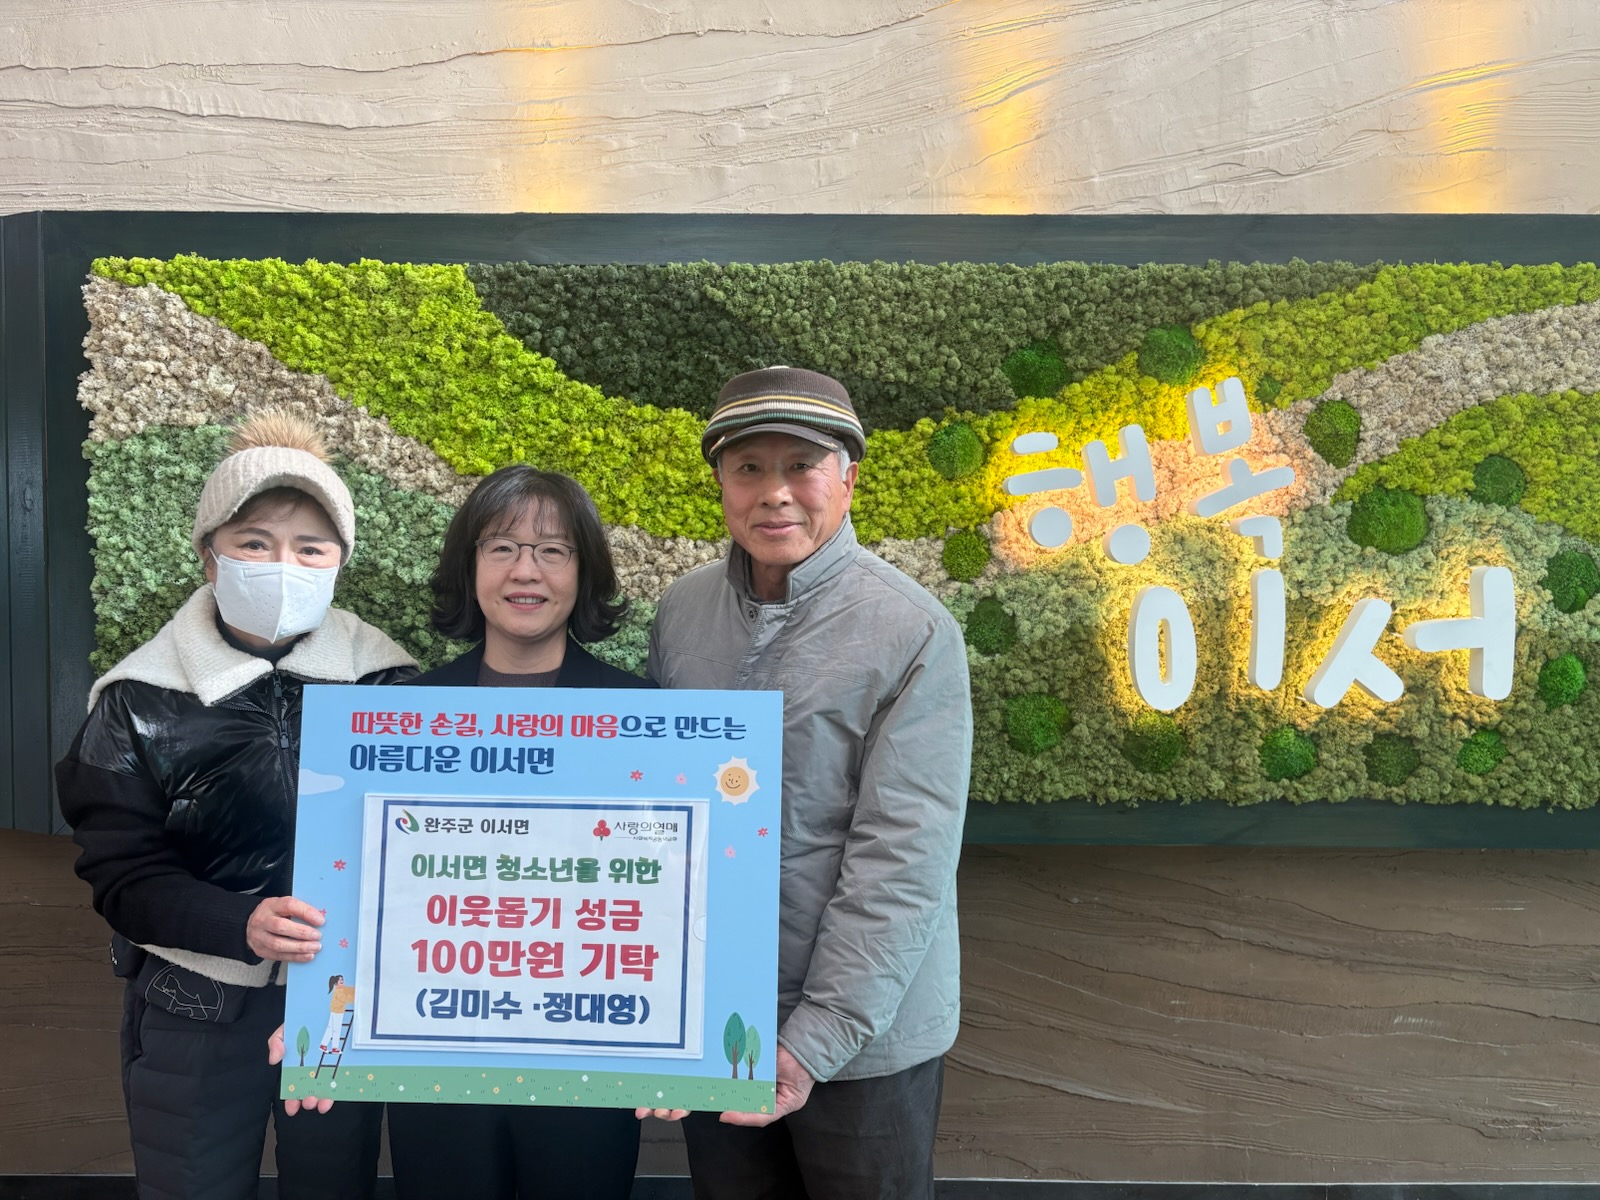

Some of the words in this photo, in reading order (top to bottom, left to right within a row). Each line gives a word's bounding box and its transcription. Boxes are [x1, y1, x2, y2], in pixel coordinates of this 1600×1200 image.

[1002, 376, 1296, 566] 행복
[1127, 566, 1517, 713] 이서
[351, 711, 424, 736] 따뜻한
[429, 712, 484, 738] 손길,
[490, 713, 564, 738] 사랑의
[570, 714, 667, 739] 마음으로
[674, 716, 747, 740] 만드는
[350, 744, 461, 774] 아름다운
[470, 746, 555, 775] 이서면
[424, 817, 474, 834] 완주군
[480, 818, 530, 835] 이서면
[614, 821, 678, 835] 사랑의열매
[411, 853, 487, 880] 이서면
[496, 853, 601, 883] 청소년을
[608, 856, 662, 885] 위한
[426, 894, 562, 930] 이웃돕기
[575, 898, 643, 932] 성금
[411, 939, 564, 979] 100만원
[579, 943, 660, 982] 기탁
[416, 988, 523, 1020] (김미수
